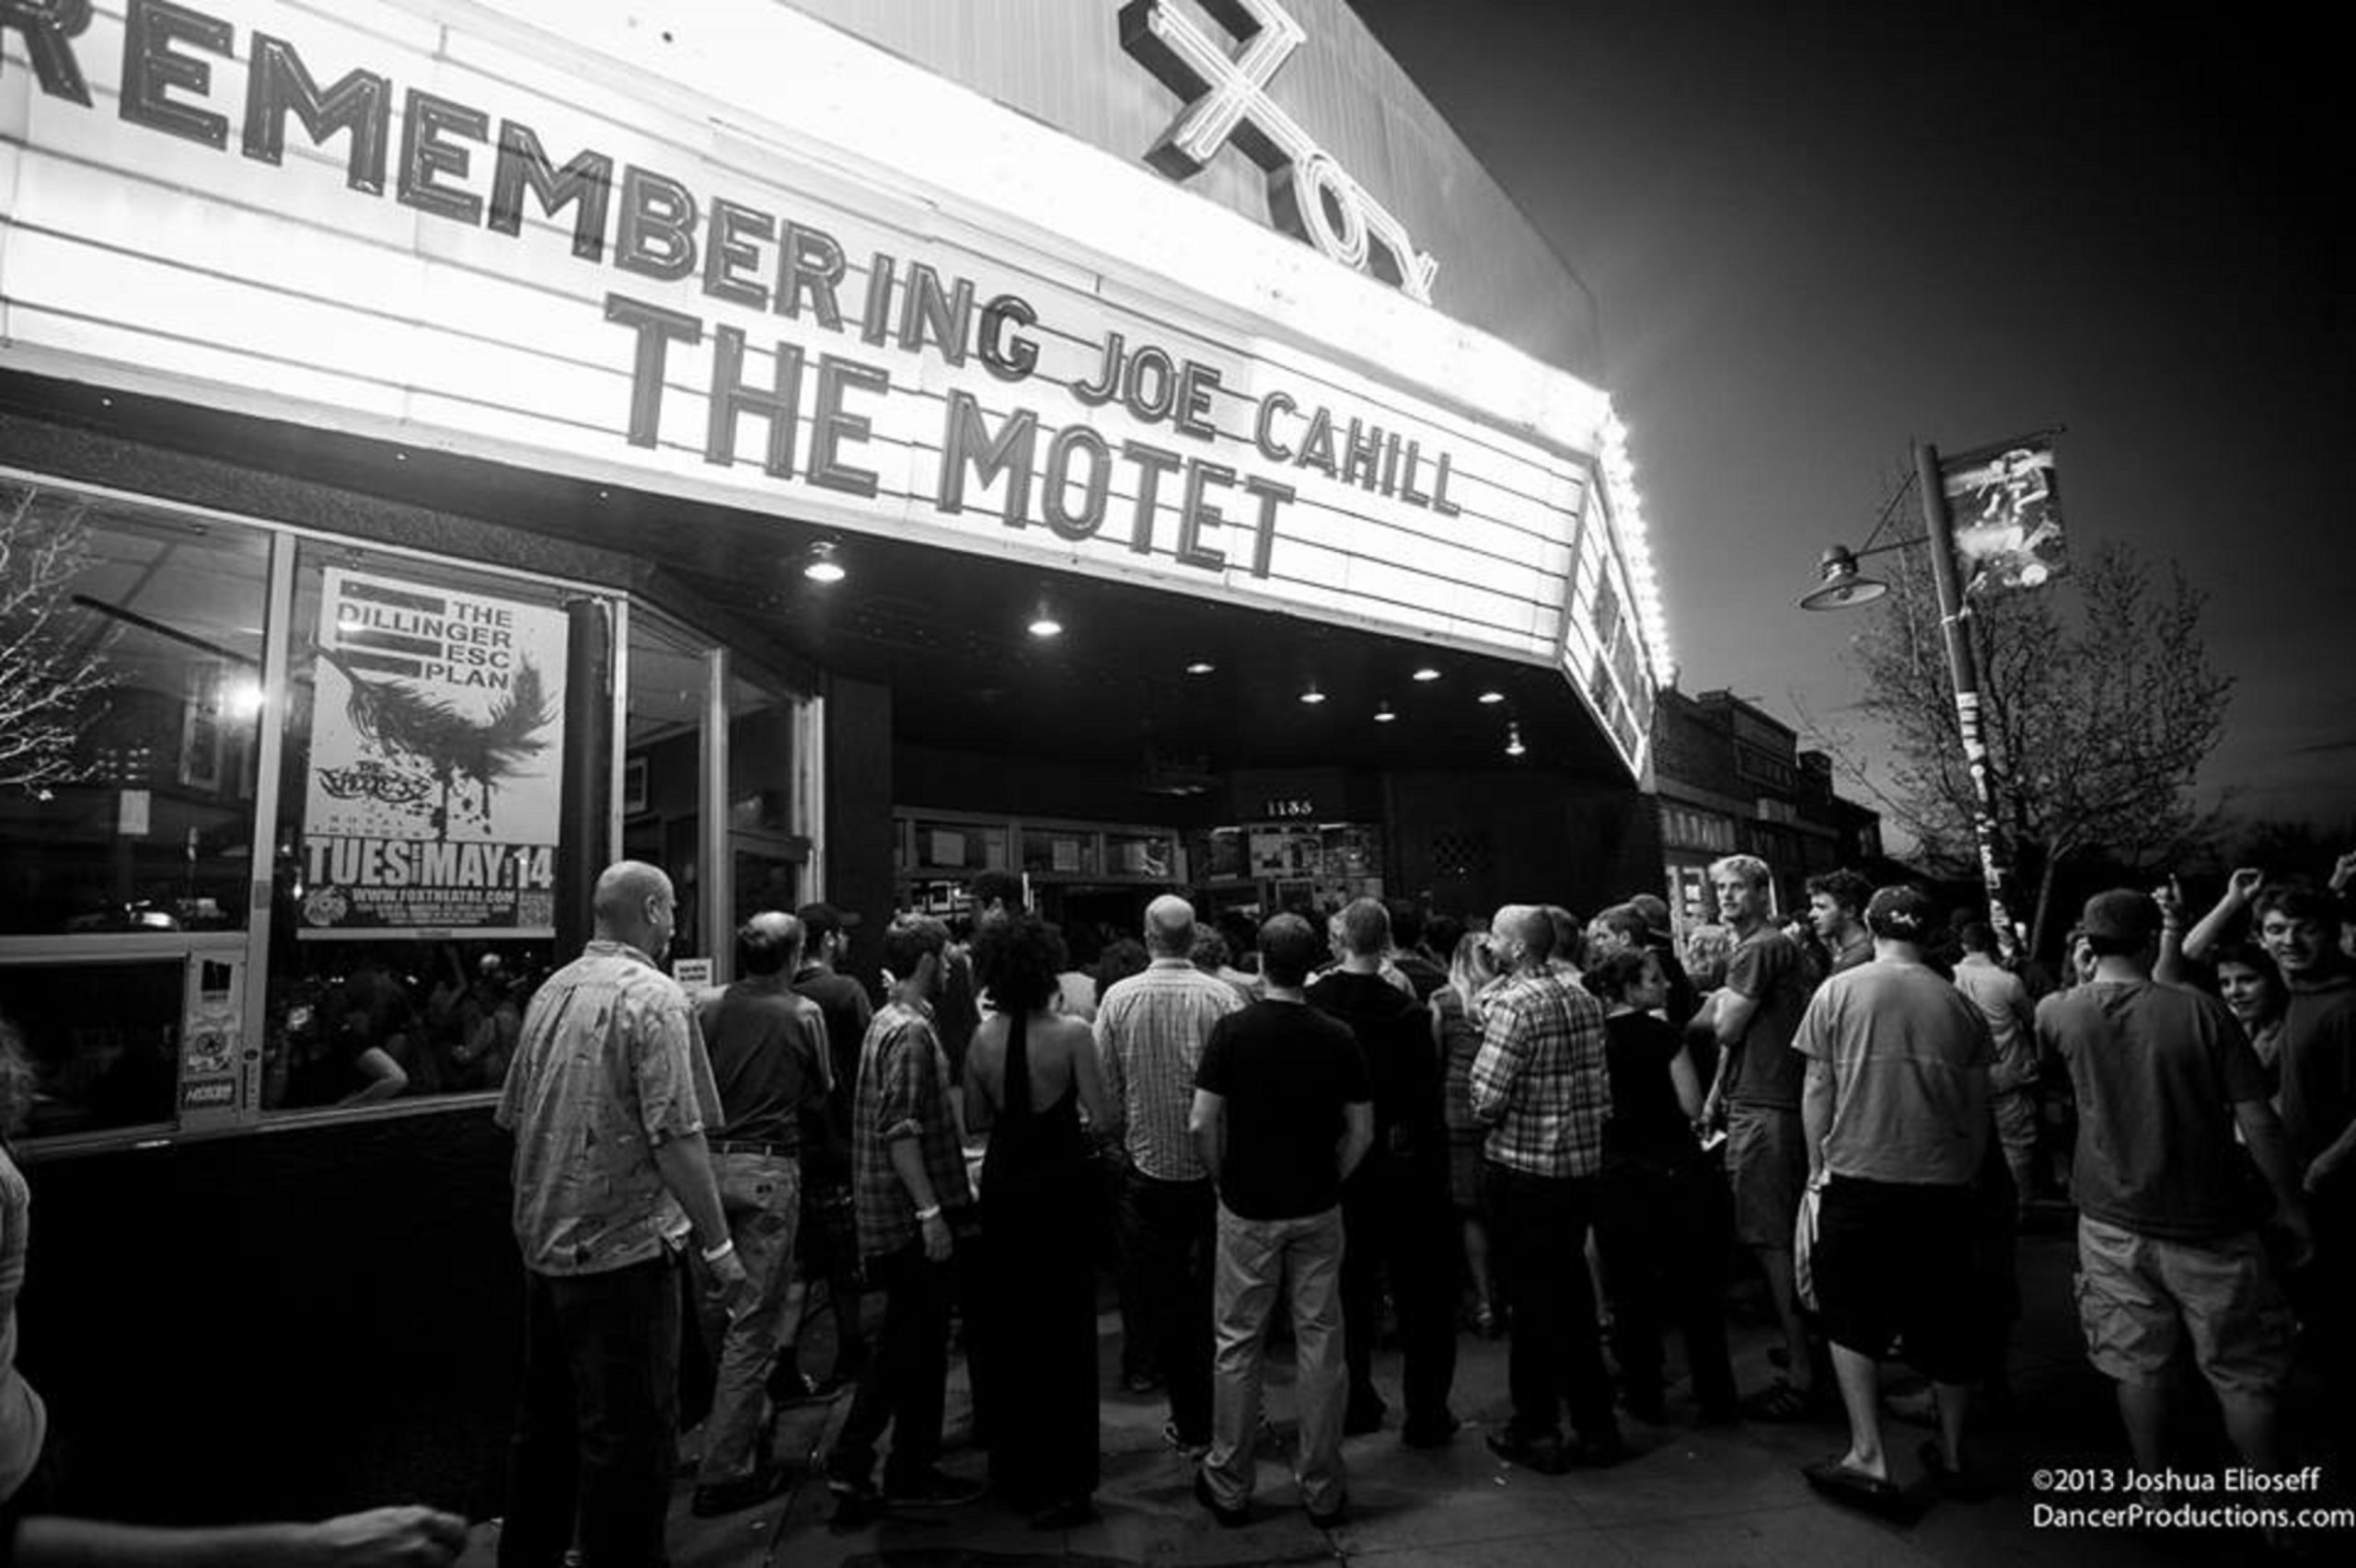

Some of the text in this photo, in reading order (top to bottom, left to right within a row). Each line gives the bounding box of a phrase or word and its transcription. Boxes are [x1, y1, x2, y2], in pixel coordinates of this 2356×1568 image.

[605, 292, 1297, 580] THE MOTET
[1068, 330, 1221, 443] JOE
[1255, 390, 1461, 517] CAHILL
[337, 603, 513, 649] DILLINGER
[454, 600, 513, 628] THE
[425, 663, 509, 690] PLAN
[447, 644, 511, 669] ESC
[305, 836, 411, 885] TUES
[422, 842, 505, 887] MAY
[513, 845, 554, 889] 14
